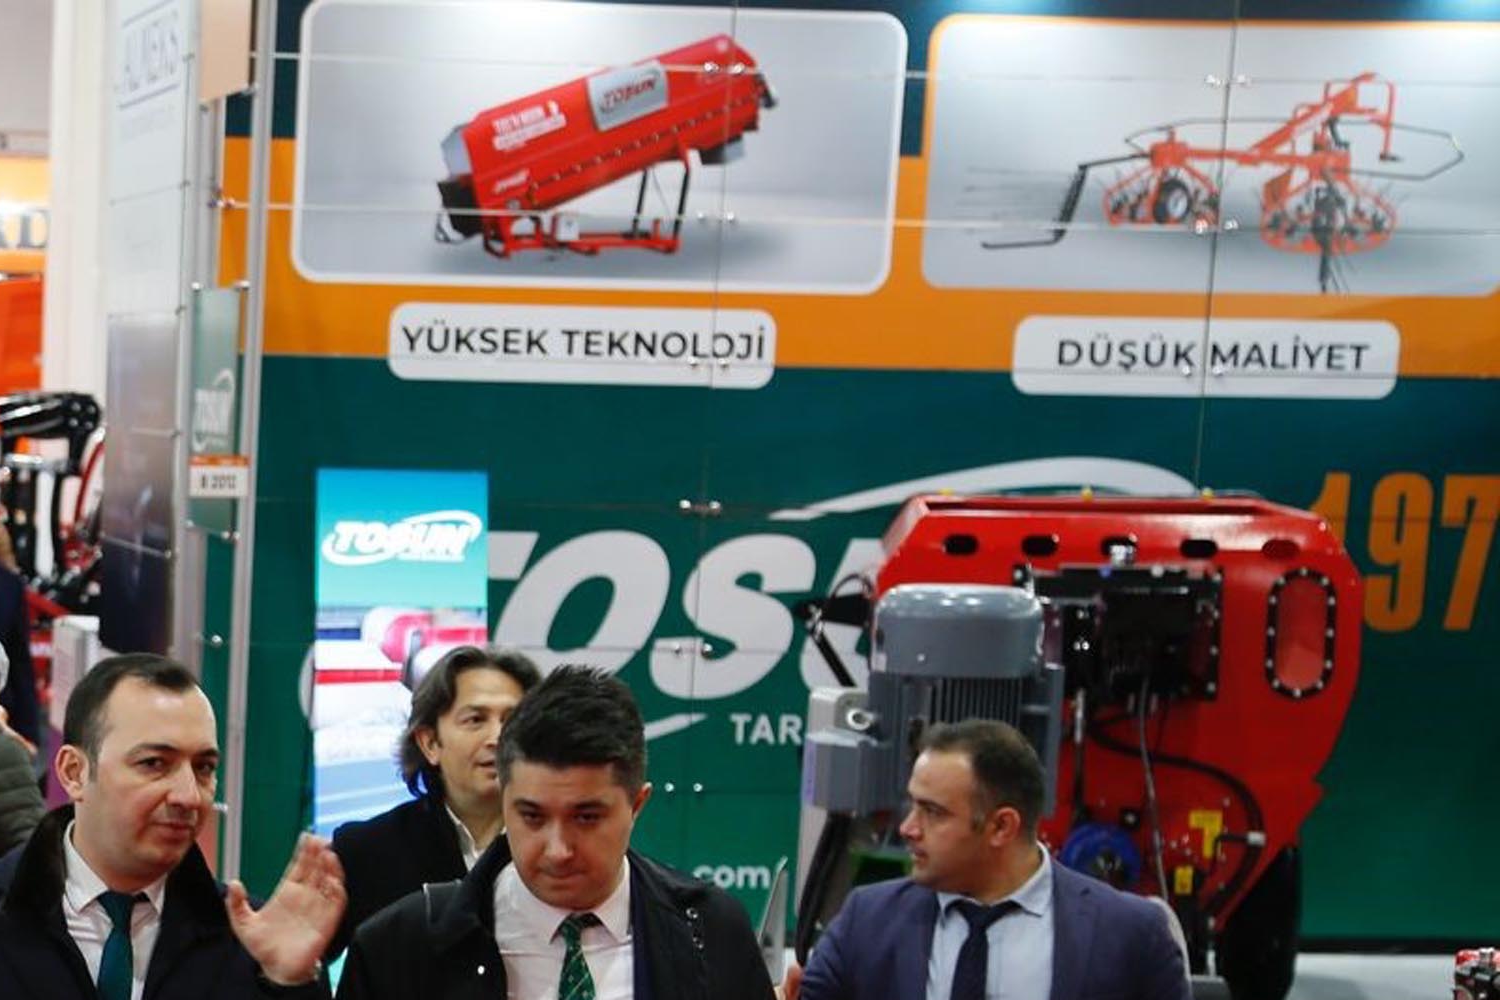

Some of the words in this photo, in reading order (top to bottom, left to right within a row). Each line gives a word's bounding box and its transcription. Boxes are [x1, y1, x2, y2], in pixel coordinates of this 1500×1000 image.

[401, 319, 549, 356] YÜKSEK
[562, 325, 765, 361] TEKNOLOJİ
[1057, 333, 1197, 372] DÜŞÜK
[1210, 335, 1371, 371] MALİYET
